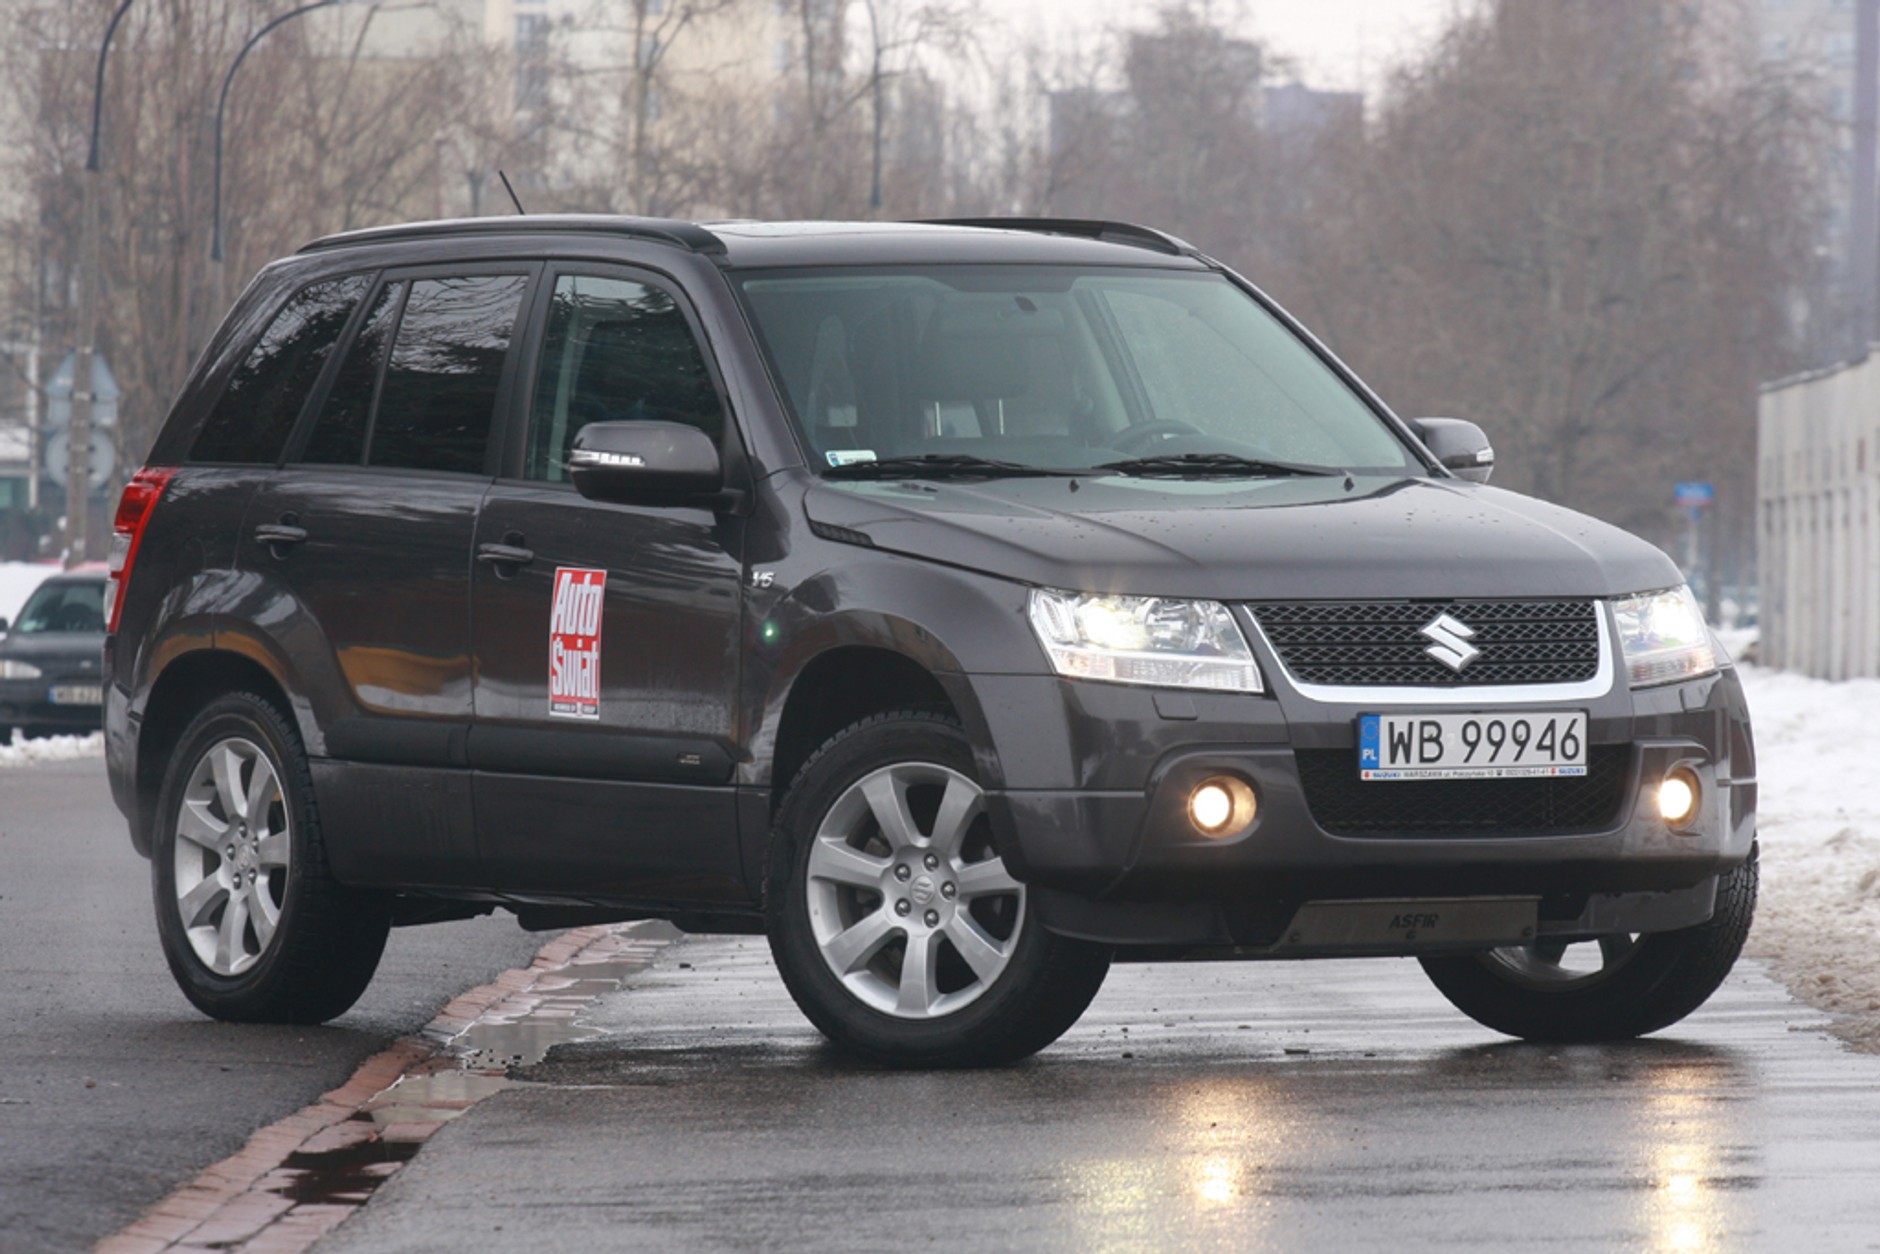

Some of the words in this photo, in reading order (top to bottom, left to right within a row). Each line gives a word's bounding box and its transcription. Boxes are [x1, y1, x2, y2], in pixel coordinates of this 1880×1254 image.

[550, 572, 602, 637] Auto
[551, 636, 599, 699] Świat
[1362, 749, 1378, 761] PL
[1388, 720, 1444, 764] WB
[1461, 718, 1580, 763] 99946
[1388, 912, 1440, 929] ASFIR
